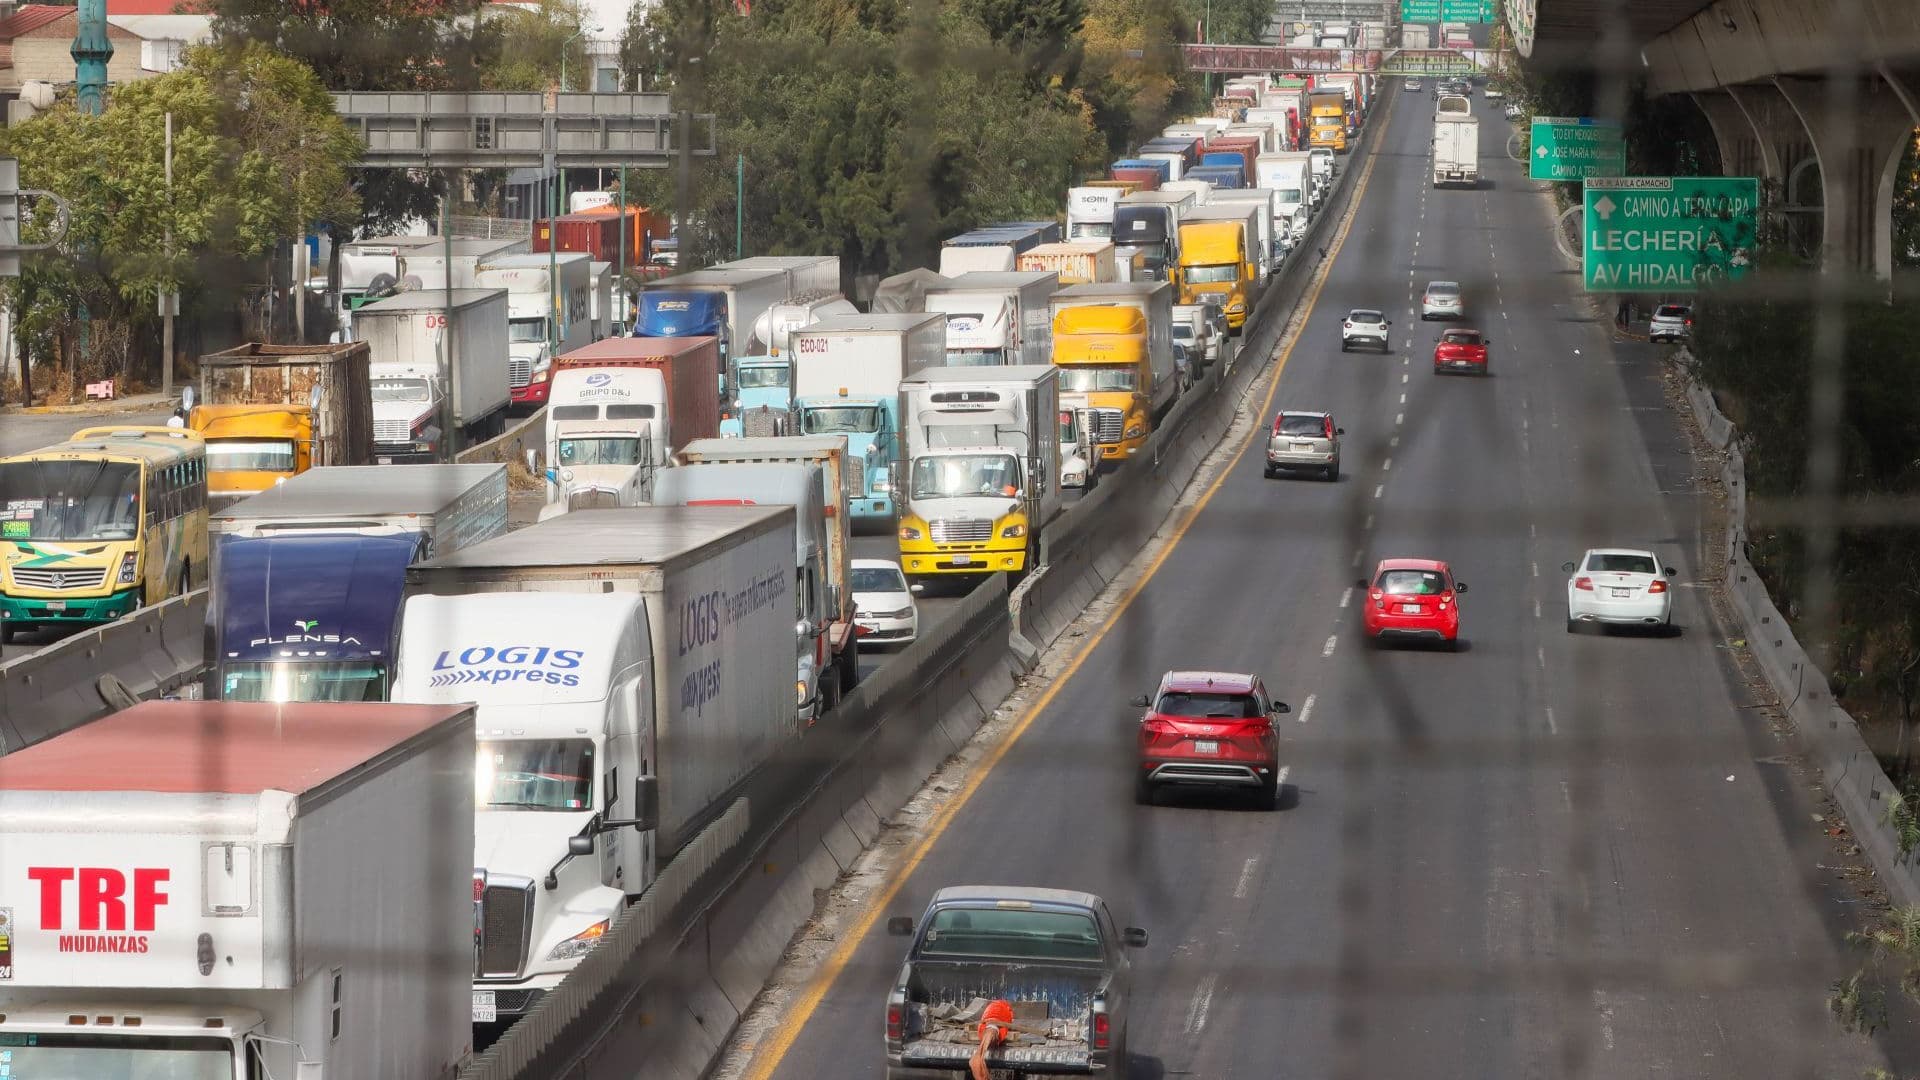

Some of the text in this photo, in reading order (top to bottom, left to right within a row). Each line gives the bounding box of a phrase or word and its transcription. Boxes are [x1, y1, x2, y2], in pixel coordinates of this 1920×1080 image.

[1552, 144, 1568, 158] JOSÉ
[1569, 145, 1589, 159] MARÍA
[1552, 164, 1577, 177] CAMINO
[1577, 165, 1583, 177] A
[1635, 179, 1669, 188] CAMACHO
[1624, 197, 1670, 218] CAMINO
[1671, 198, 1681, 218] A
[1592, 226, 1723, 251] LECHERÍA
[1592, 264, 1623, 285] AV
[800, 338, 829, 353] ECO-021
[579, 388, 631, 398] GRUPO D&J
[679, 590, 719, 656] LOGIS
[251, 634, 361, 648] FLENSA
[433, 646, 584, 671] LOGIS
[473, 669, 580, 687] xpress
[27, 867, 170, 931] TRF
[59, 935, 149, 954] MUDANZAS
